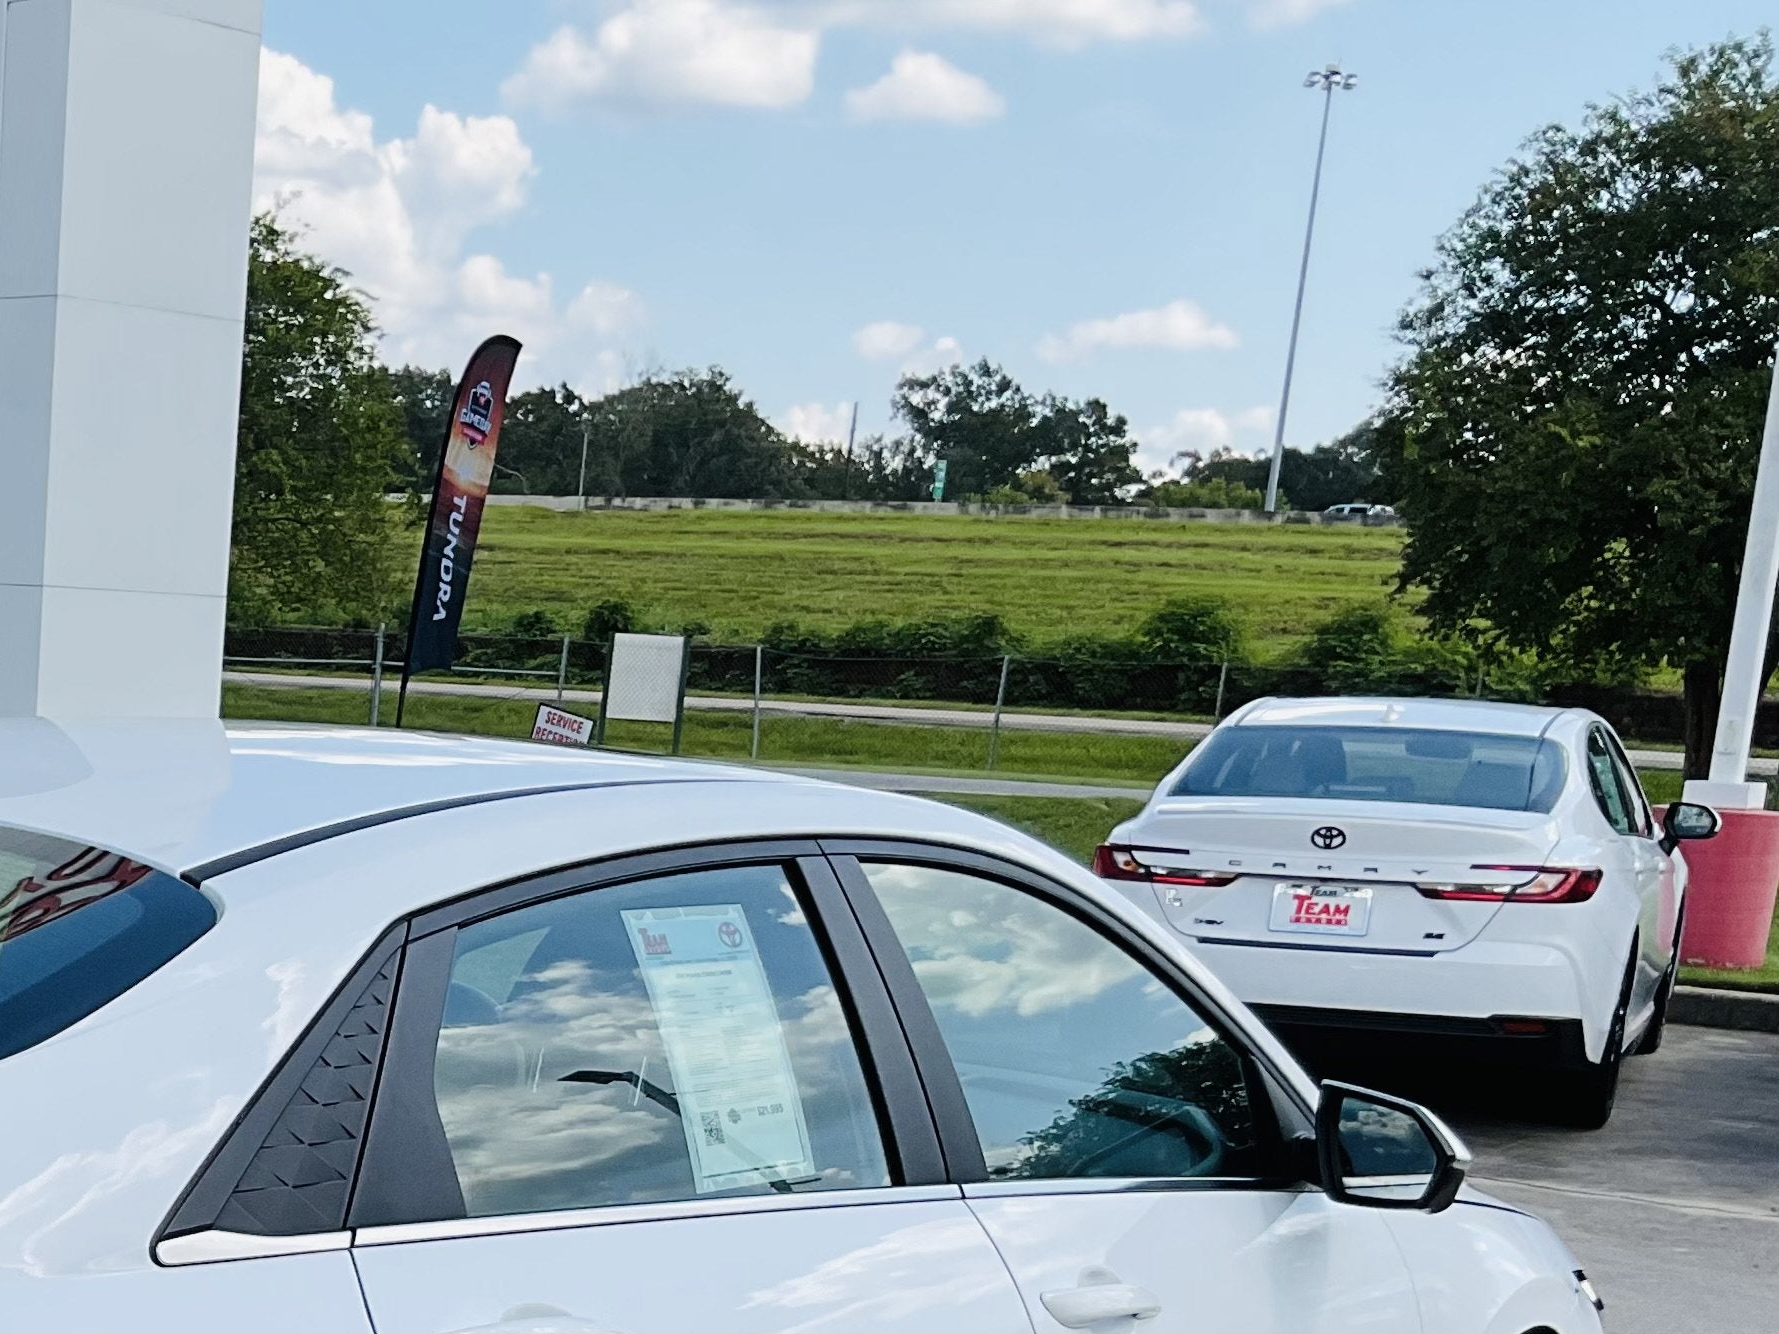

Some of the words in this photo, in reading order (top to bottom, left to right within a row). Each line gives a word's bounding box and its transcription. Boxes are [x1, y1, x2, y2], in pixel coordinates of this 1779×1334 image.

[432, 495, 468, 622] TUNDRA
[545, 710, 584, 735] SERVICE
[1293, 894, 1351, 917] TEAM
